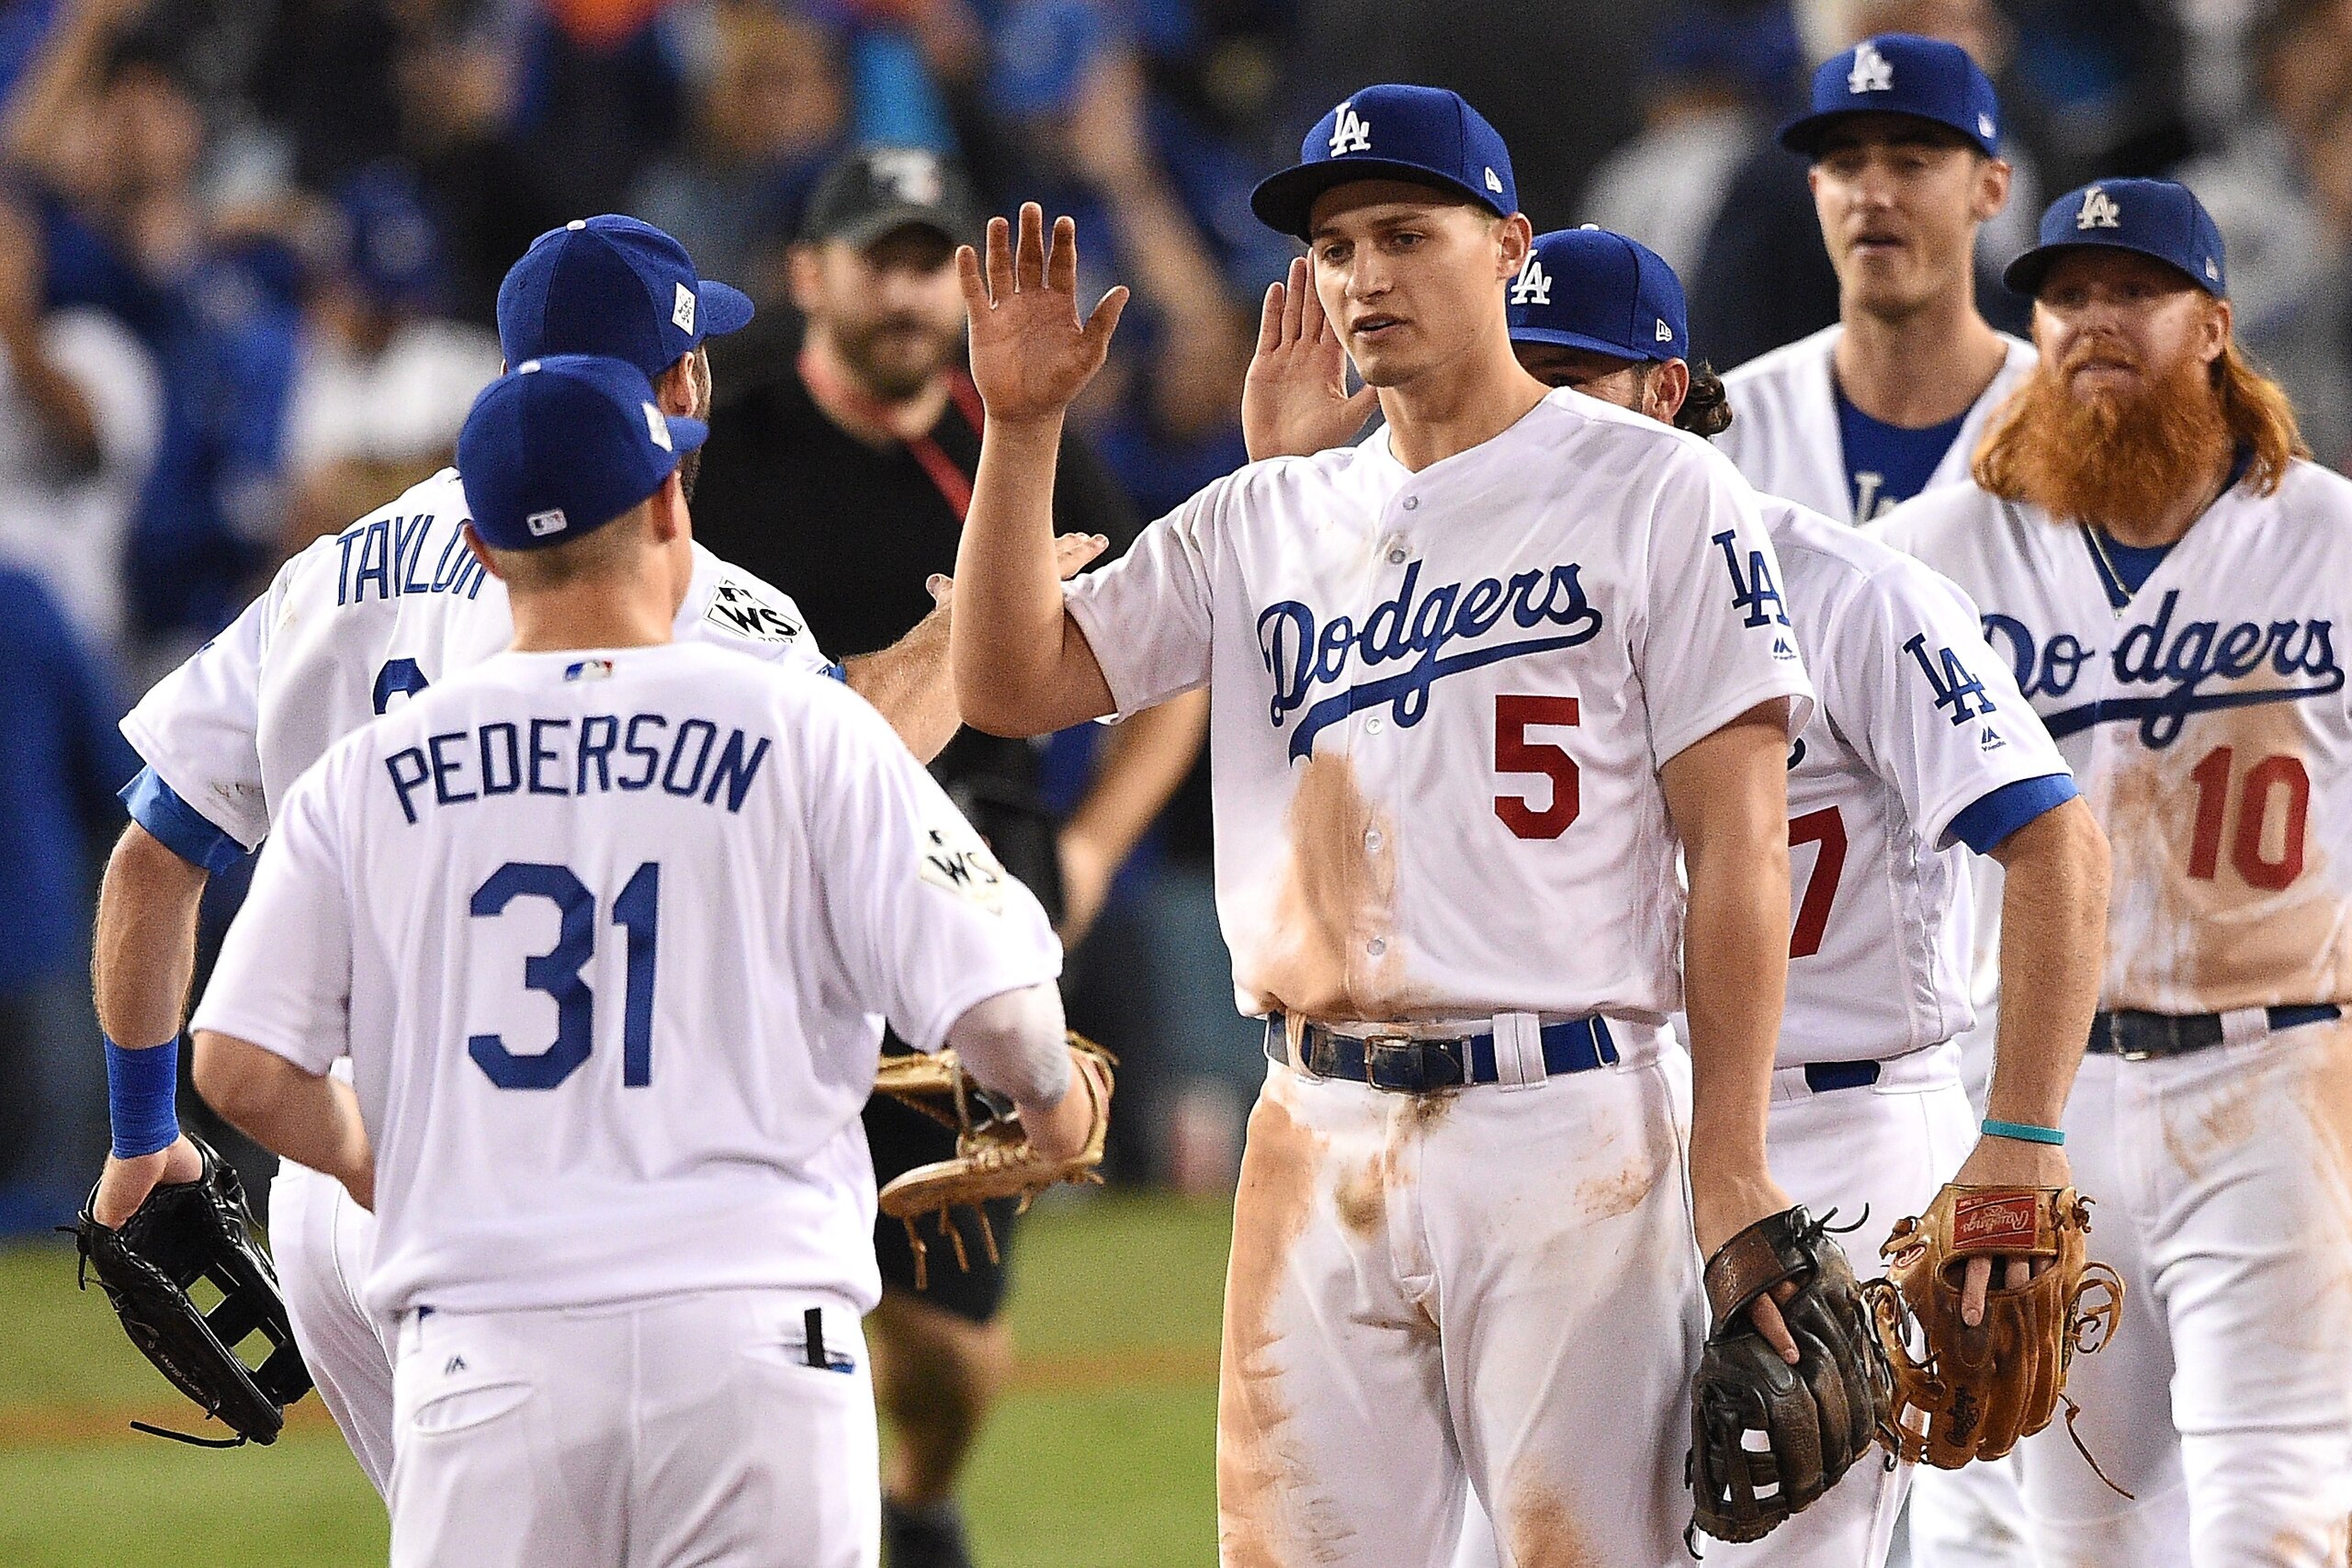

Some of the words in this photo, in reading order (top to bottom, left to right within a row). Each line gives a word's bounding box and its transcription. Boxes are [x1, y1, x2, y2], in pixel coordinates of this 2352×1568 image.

[1848, 42, 1893, 94] LA
[1329, 101, 1372, 158] LA
[2076, 186, 2121, 230] LA
[1510, 249, 1553, 305] LA
[714, 604, 797, 637] WS
[1711, 528, 1792, 629] LA
[1256, 558, 1603, 728] Dodgers
[1902, 632, 1996, 727] LA
[1981, 589, 2345, 750] Dodgers
[384, 713, 773, 825] PEDERSON
[1494, 694, 1580, 840] 5
[2187, 745, 2311, 892] 10
[927, 851, 999, 886] WS
[468, 862, 660, 1089] 31
[1961, 1209, 2030, 1234] Rawlings
